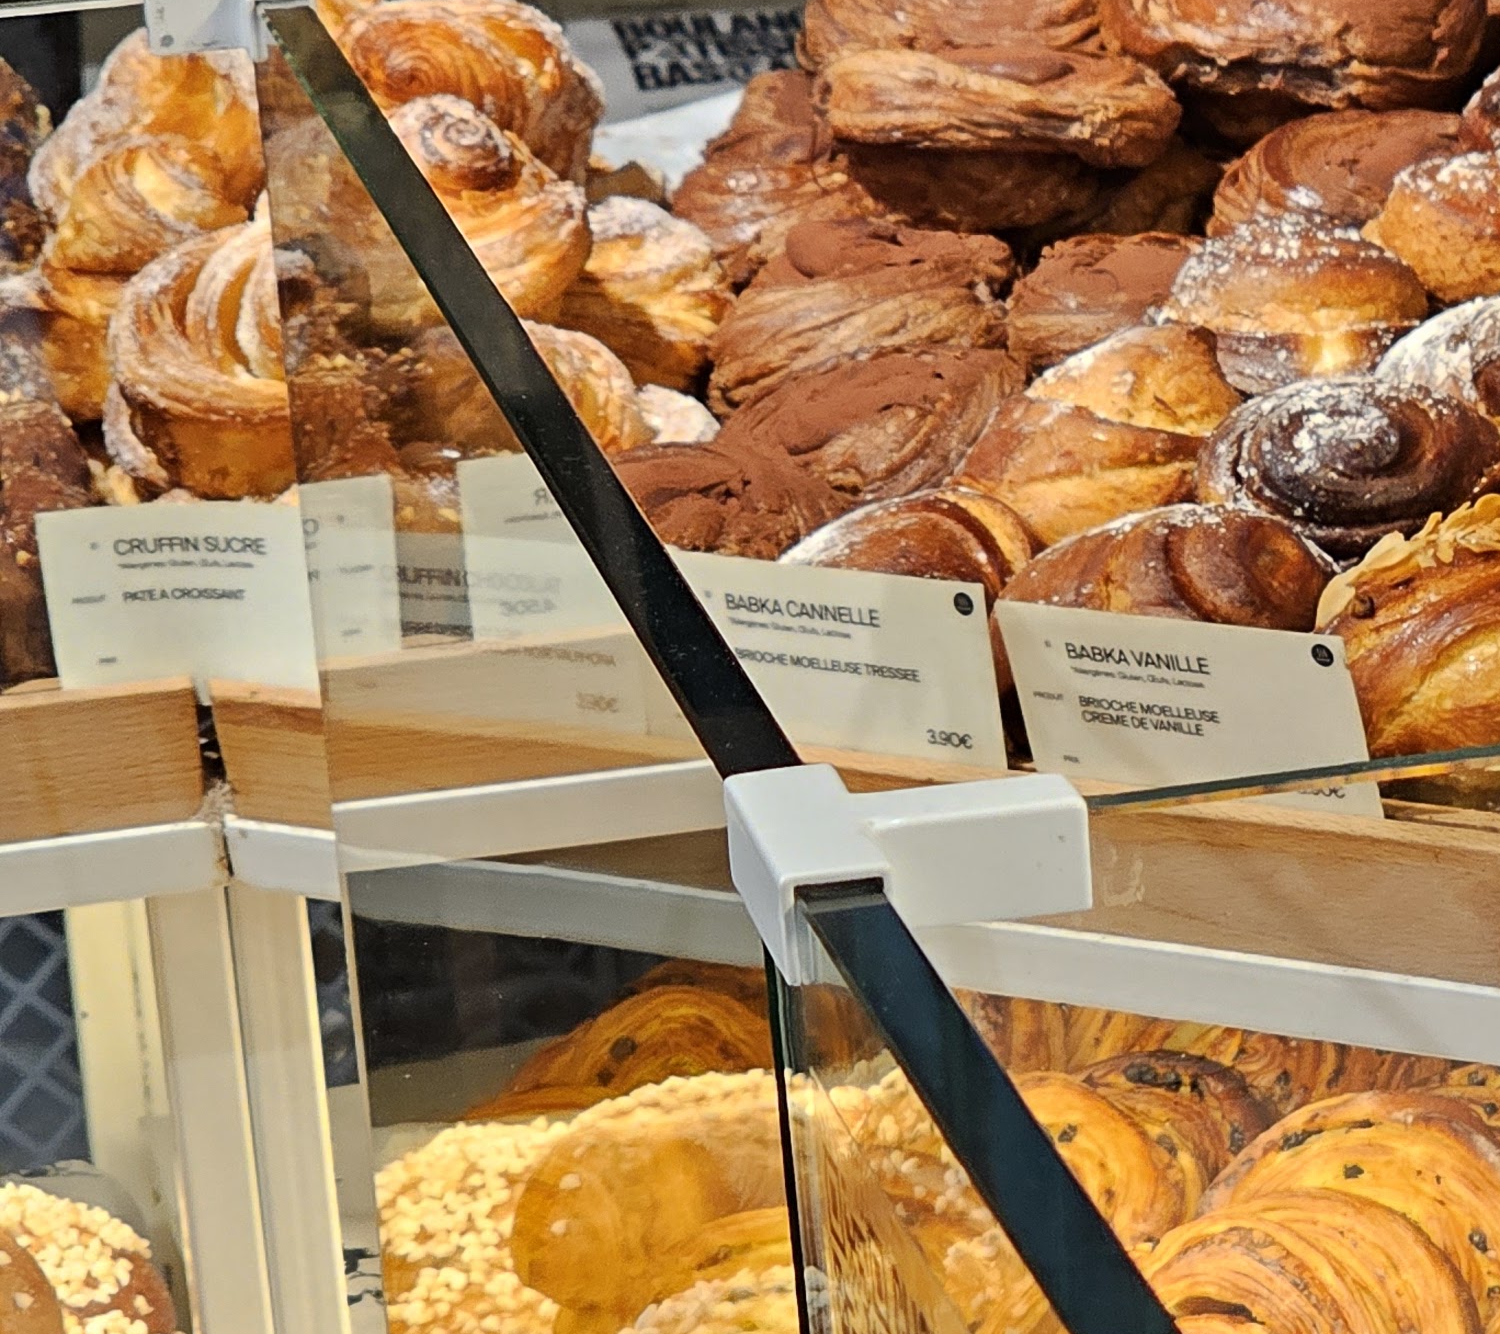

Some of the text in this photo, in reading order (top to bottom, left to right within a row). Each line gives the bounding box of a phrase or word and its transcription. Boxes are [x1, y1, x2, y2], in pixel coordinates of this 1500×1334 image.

[113, 535, 267, 556] CRUFFIN SUCRE
[725, 593, 784, 616] BABKA
[786, 600, 881, 628] CANNELLE
[735, 647, 788, 666] BRIOCHE
[789, 654, 862, 676] MOELLEUSE
[1065, 642, 1211, 676] BABKA VANILLE
[1079, 695, 1220, 724] BRIOCHE MOELLEUSE
[1081, 710, 1204, 737] CREME DE VANILLE
